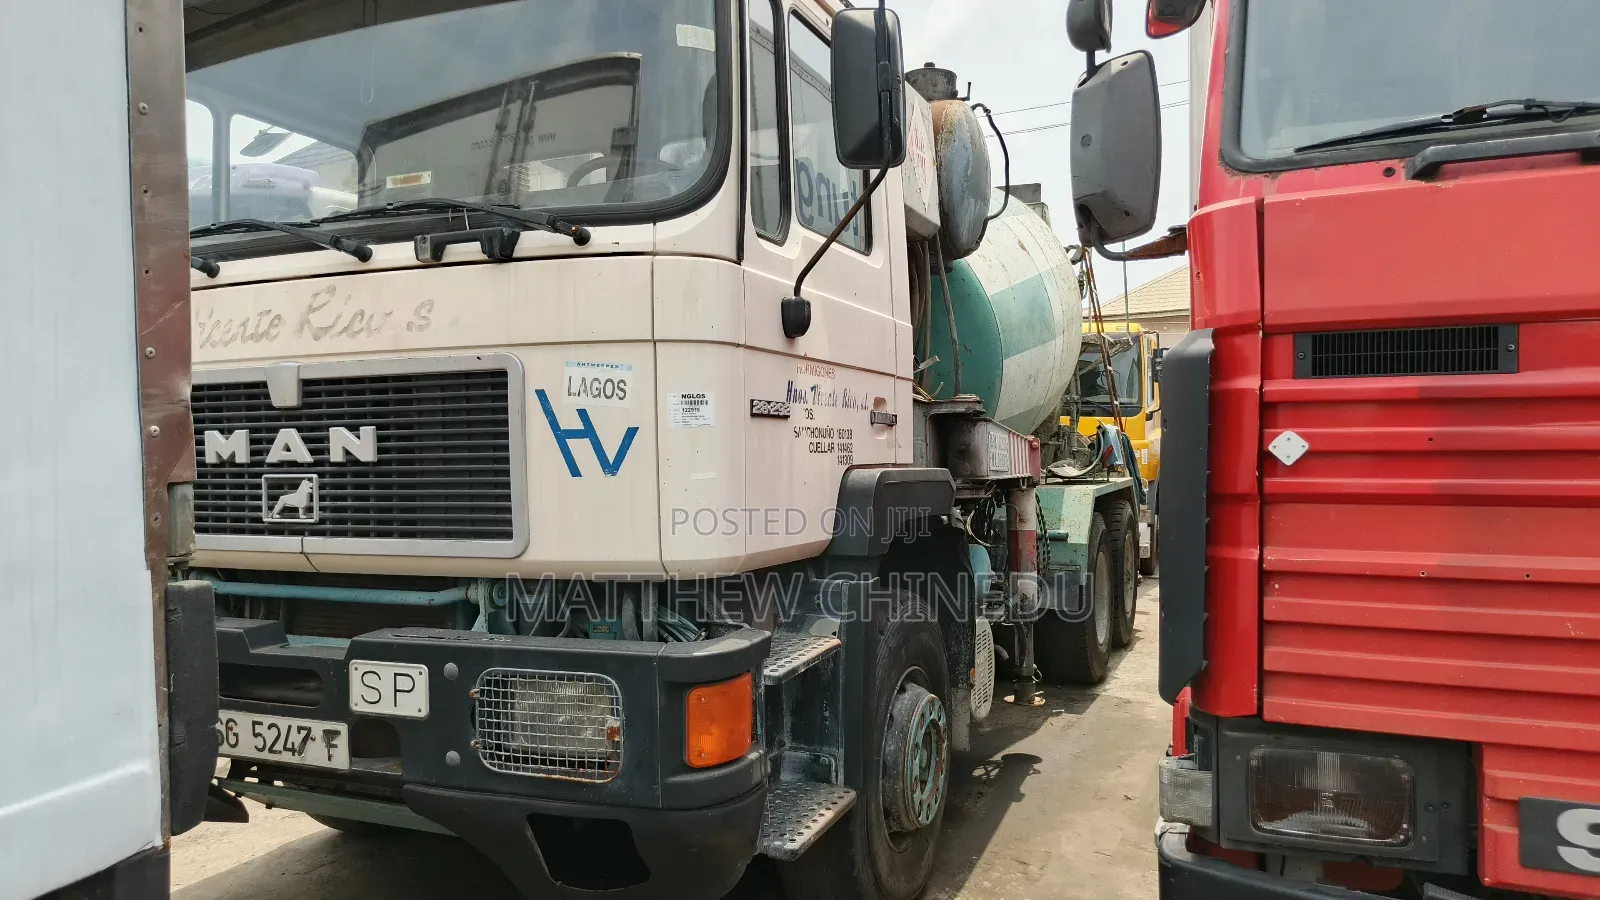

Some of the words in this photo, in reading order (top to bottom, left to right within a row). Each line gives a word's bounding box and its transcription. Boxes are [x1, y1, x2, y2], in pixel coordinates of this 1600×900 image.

[567, 375, 627, 401] LAGOS
[203, 425, 378, 465] MAN
[535, 388, 640, 478] HV
[808, 441, 835, 454] CUELLAR
